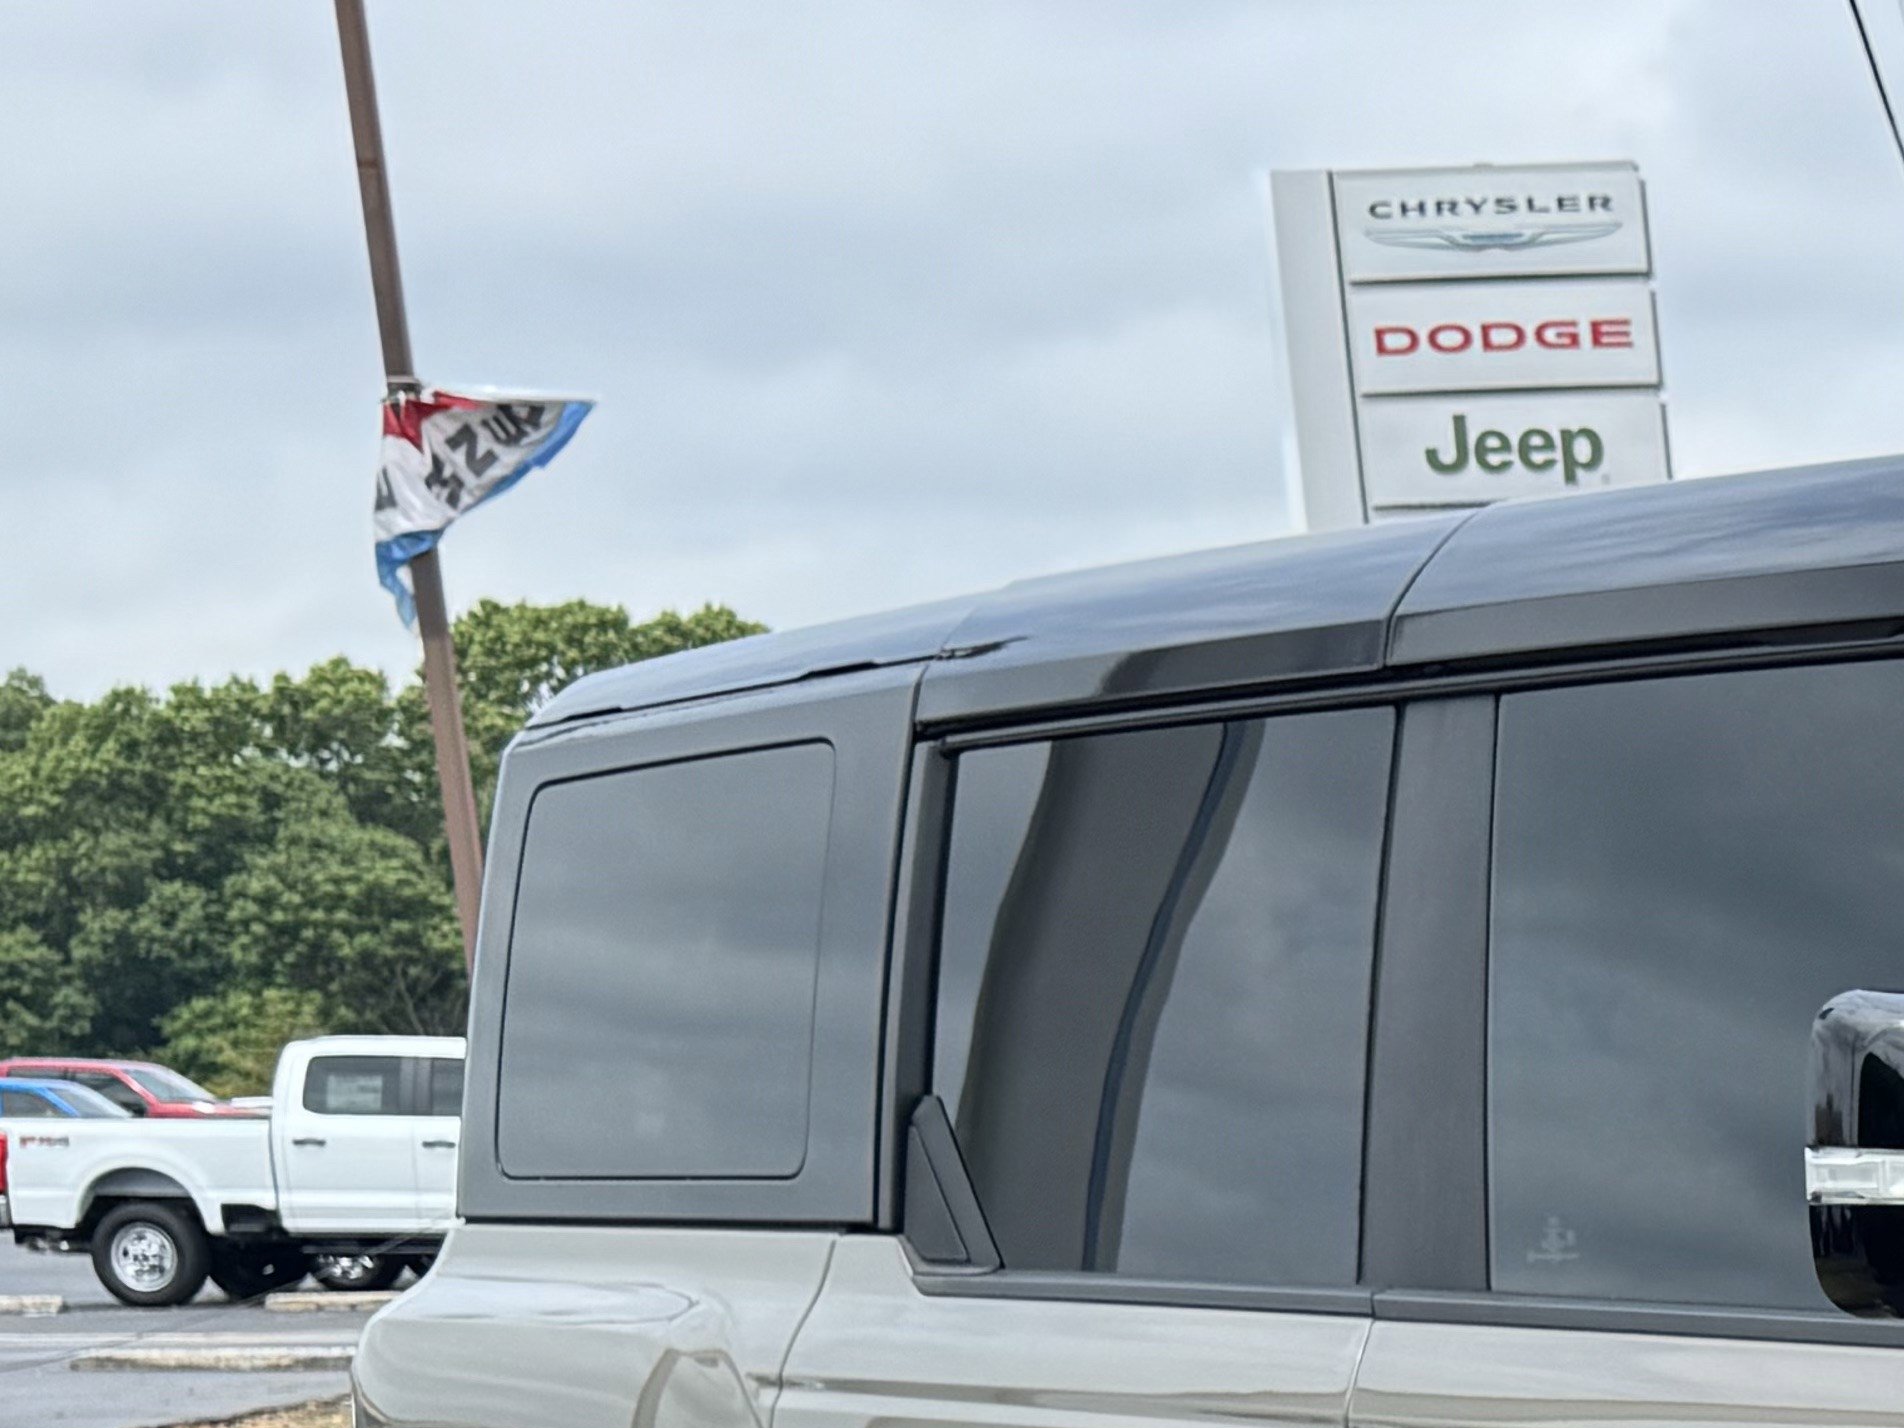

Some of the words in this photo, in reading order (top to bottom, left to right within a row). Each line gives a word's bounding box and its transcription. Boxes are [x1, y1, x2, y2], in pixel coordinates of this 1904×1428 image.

[1367, 193, 1614, 220] CHRYSLER
[1373, 318, 1634, 357] DODGE
[1424, 413, 1604, 485] Jeep
